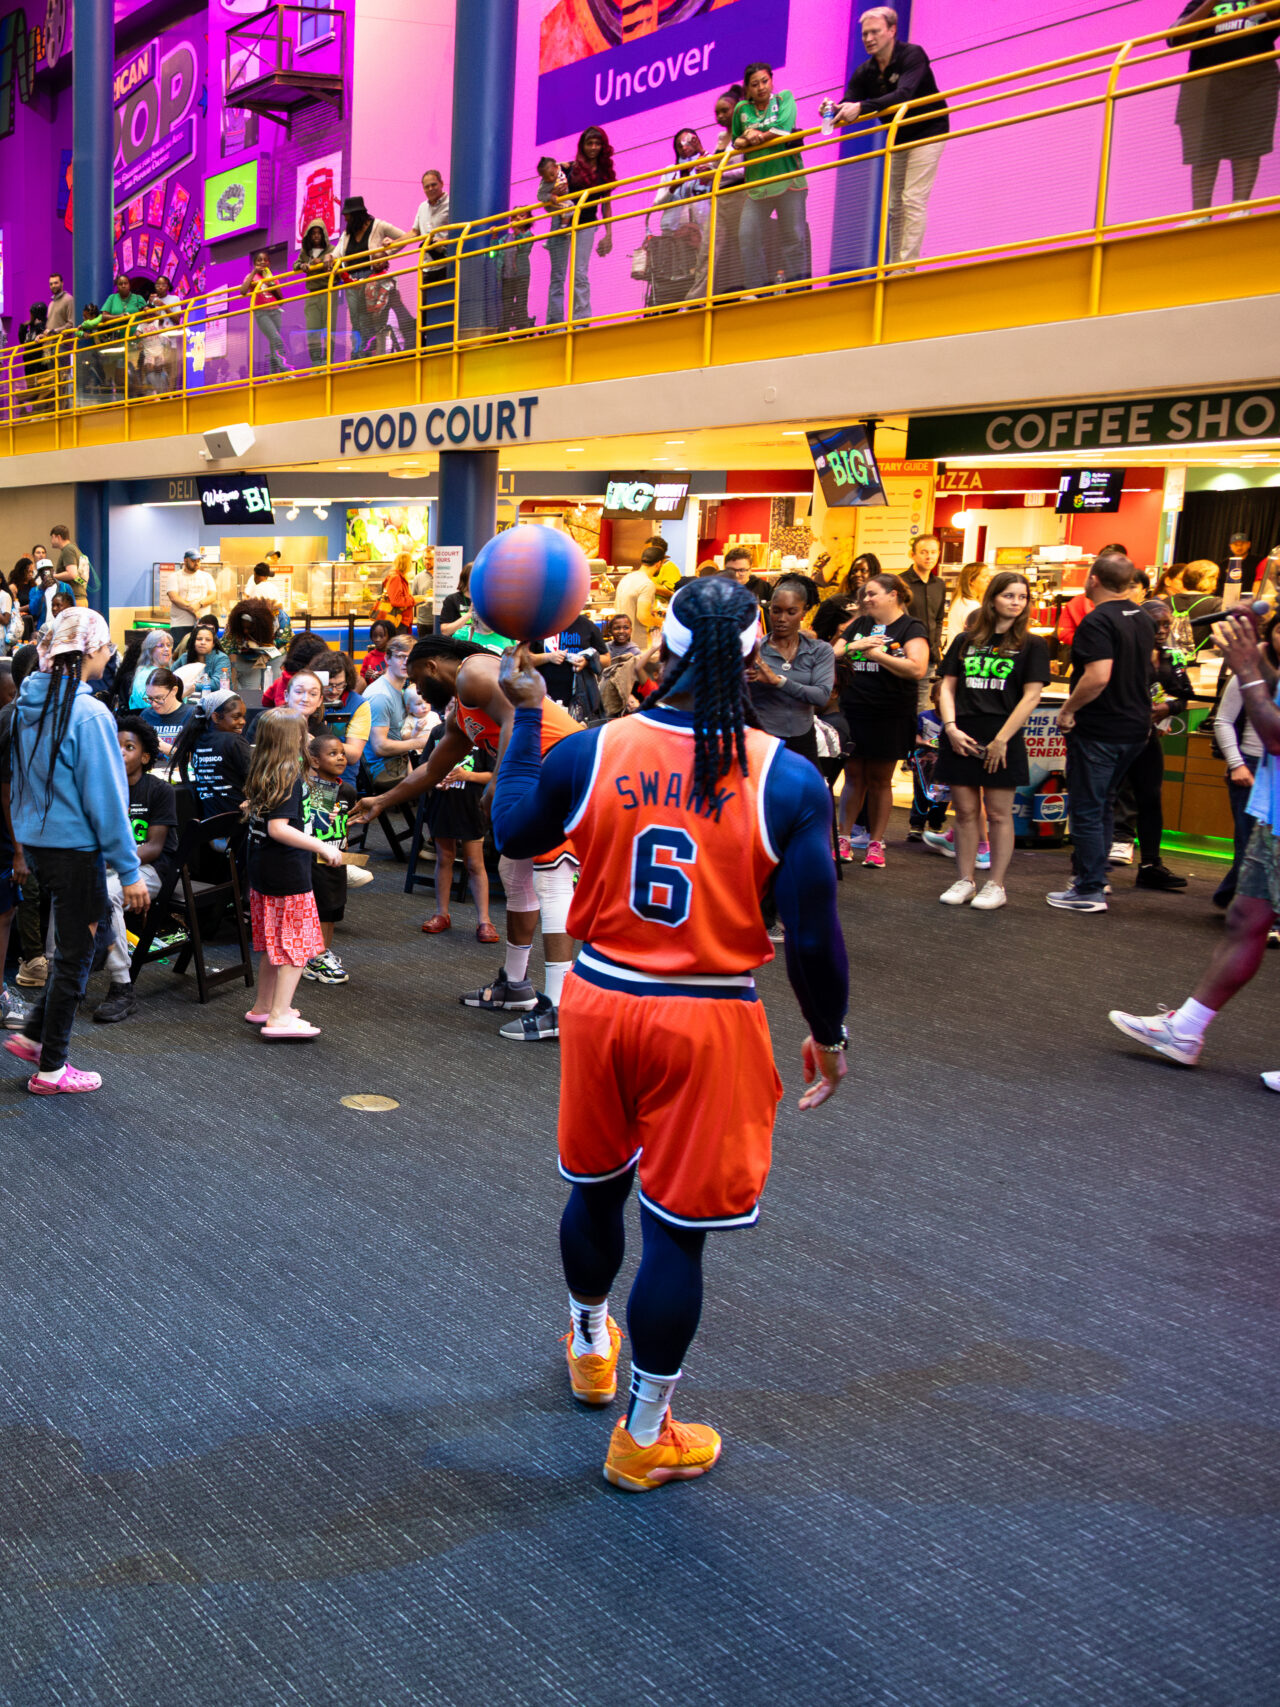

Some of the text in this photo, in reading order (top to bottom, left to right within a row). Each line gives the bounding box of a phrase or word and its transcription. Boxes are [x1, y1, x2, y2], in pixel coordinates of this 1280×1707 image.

[595, 40, 716, 106] Uncover
[340, 396, 539, 453] FOOD COURT
[985, 395, 1276, 451] COFFEE SHO
[826, 448, 870, 487] BIG
[878, 462, 929, 472] TARY GUIDE
[168, 479, 193, 499] DELI
[497, 473, 515, 494] LI
[560, 632, 581, 645] Math
[964, 656, 1015, 680] BIG
[1024, 737, 1045, 747] OR
[1025, 748, 1067, 757] ENERA
[629, 824, 698, 928] 6
